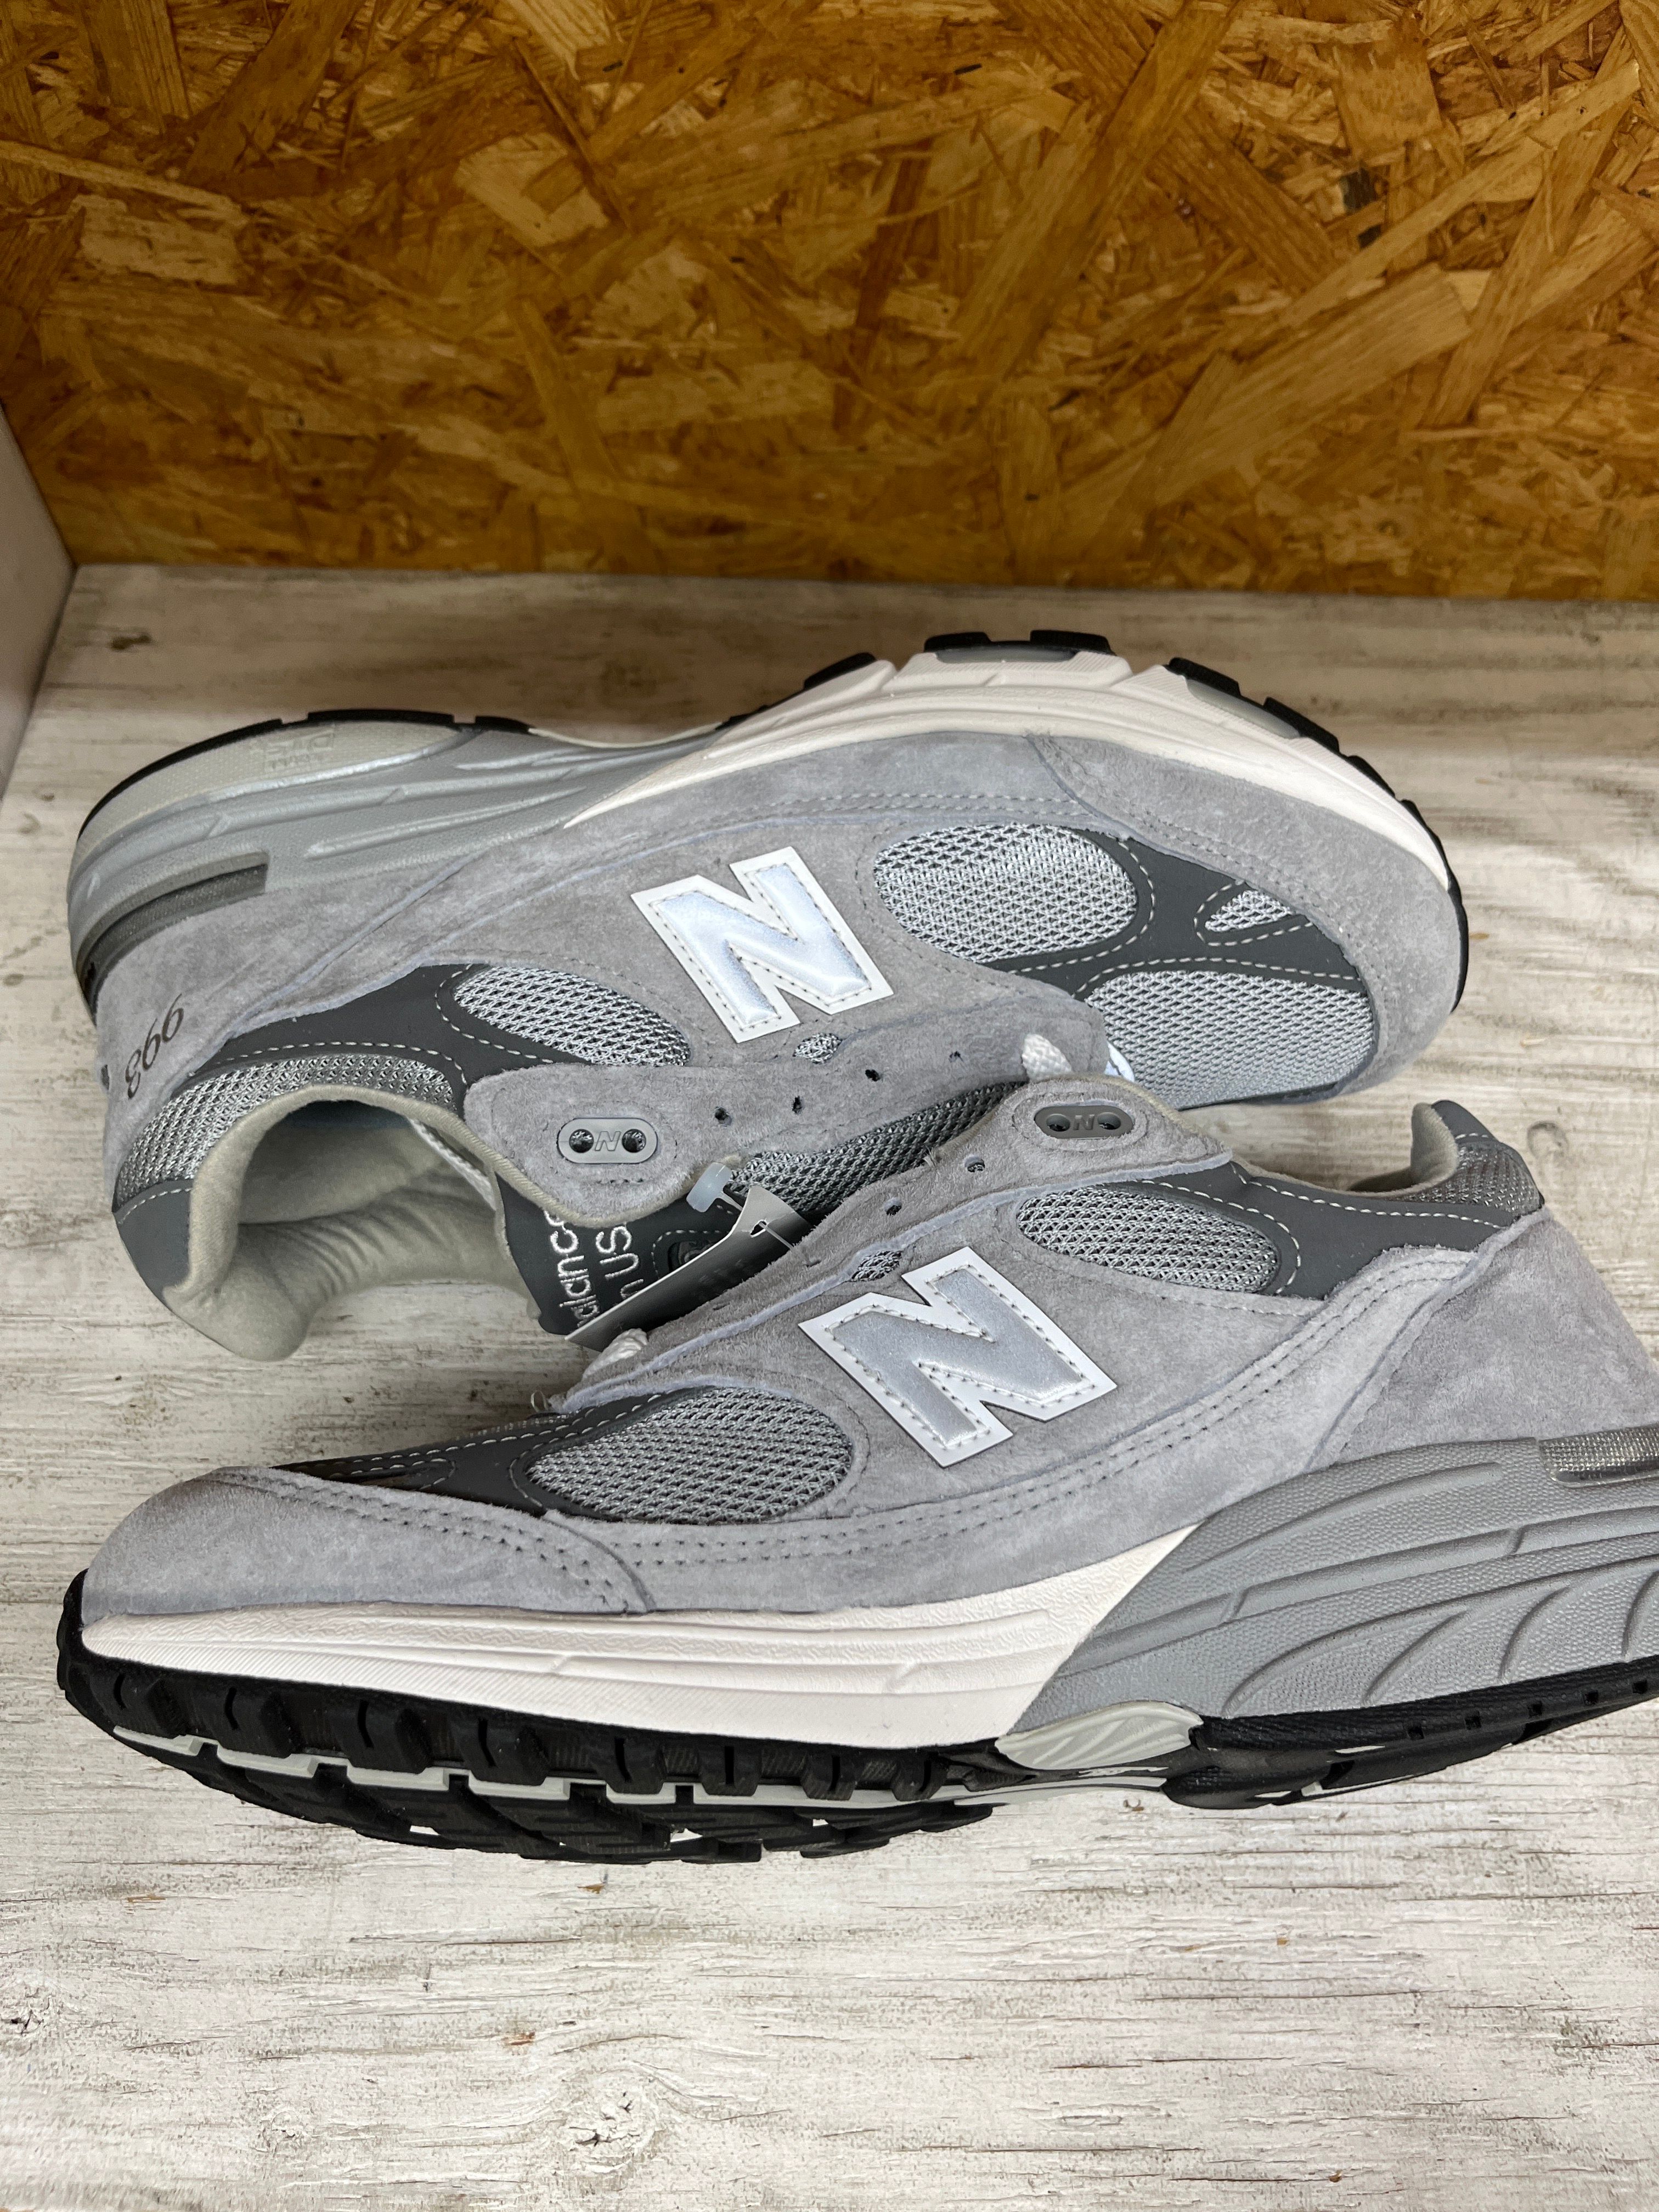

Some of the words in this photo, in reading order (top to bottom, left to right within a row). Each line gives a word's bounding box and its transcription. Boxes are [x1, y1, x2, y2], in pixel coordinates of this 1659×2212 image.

[631, 846, 894, 1043] N
[125, 994, 184, 1100] 993
[594, 1131, 621, 1152] N
[798, 1246, 1118, 1469] N
